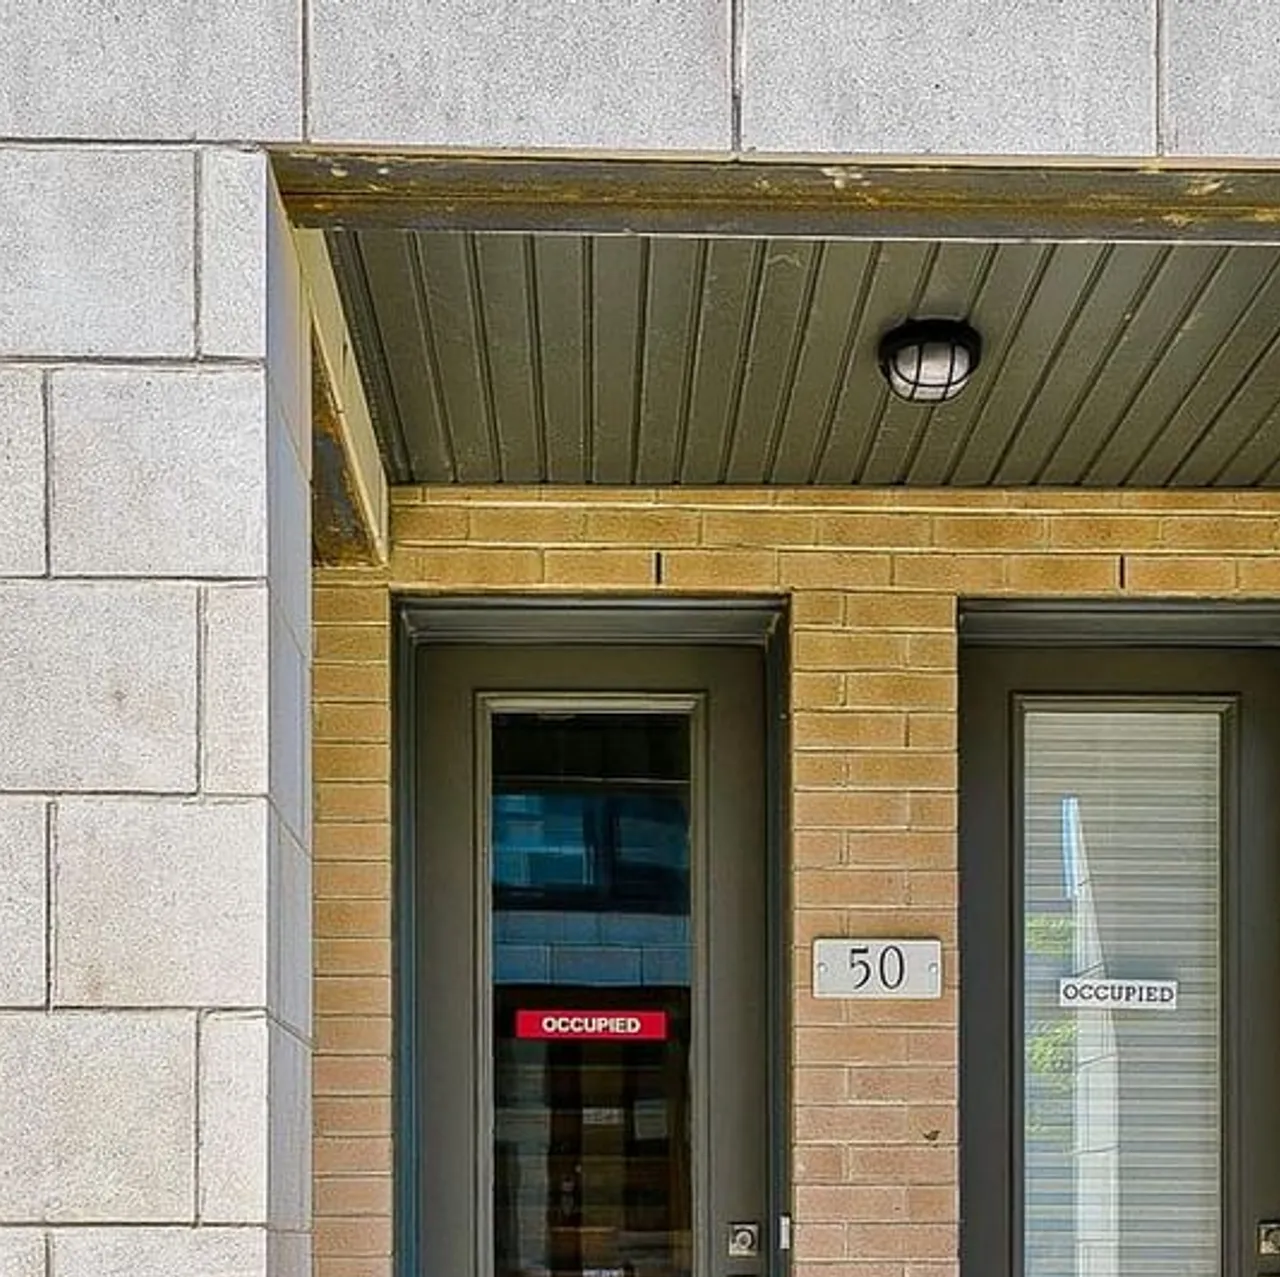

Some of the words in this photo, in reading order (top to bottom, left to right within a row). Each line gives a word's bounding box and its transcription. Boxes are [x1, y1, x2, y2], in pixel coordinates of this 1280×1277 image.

[849, 944, 905, 990] 50
[1062, 983, 1175, 1003] OCCUPIED
[541, 1016, 642, 1034] OCCUPIED
